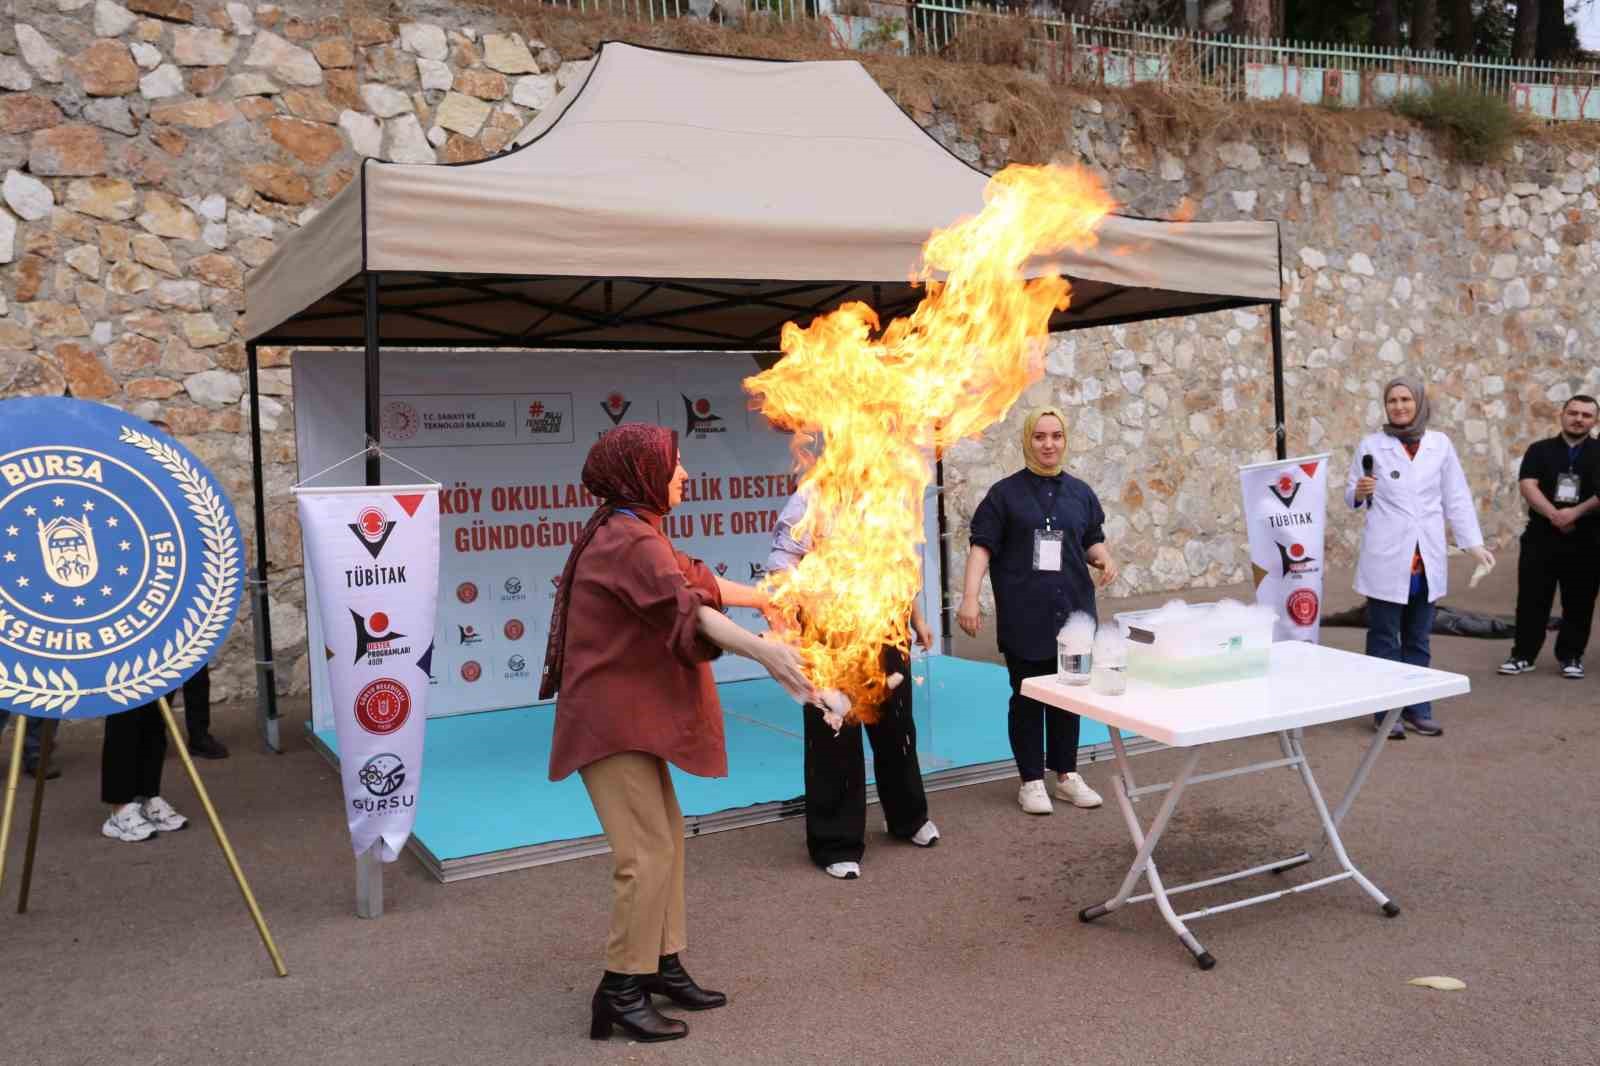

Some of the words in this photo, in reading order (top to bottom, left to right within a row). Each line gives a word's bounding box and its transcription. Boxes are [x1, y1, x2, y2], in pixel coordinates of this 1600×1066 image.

[2, 455, 104, 487] BURSA
[438, 481, 482, 514] KÖY
[680, 471, 722, 502] ELİK
[701, 512, 724, 537] VE
[730, 509, 778, 535] ORTA
[1268, 511, 1313, 528] TÜBİTAK
[0, 599, 93, 650] KŞEHİR
[99, 531, 176, 647] BELEDİYESİ
[345, 564, 406, 588] TÜBİTAK
